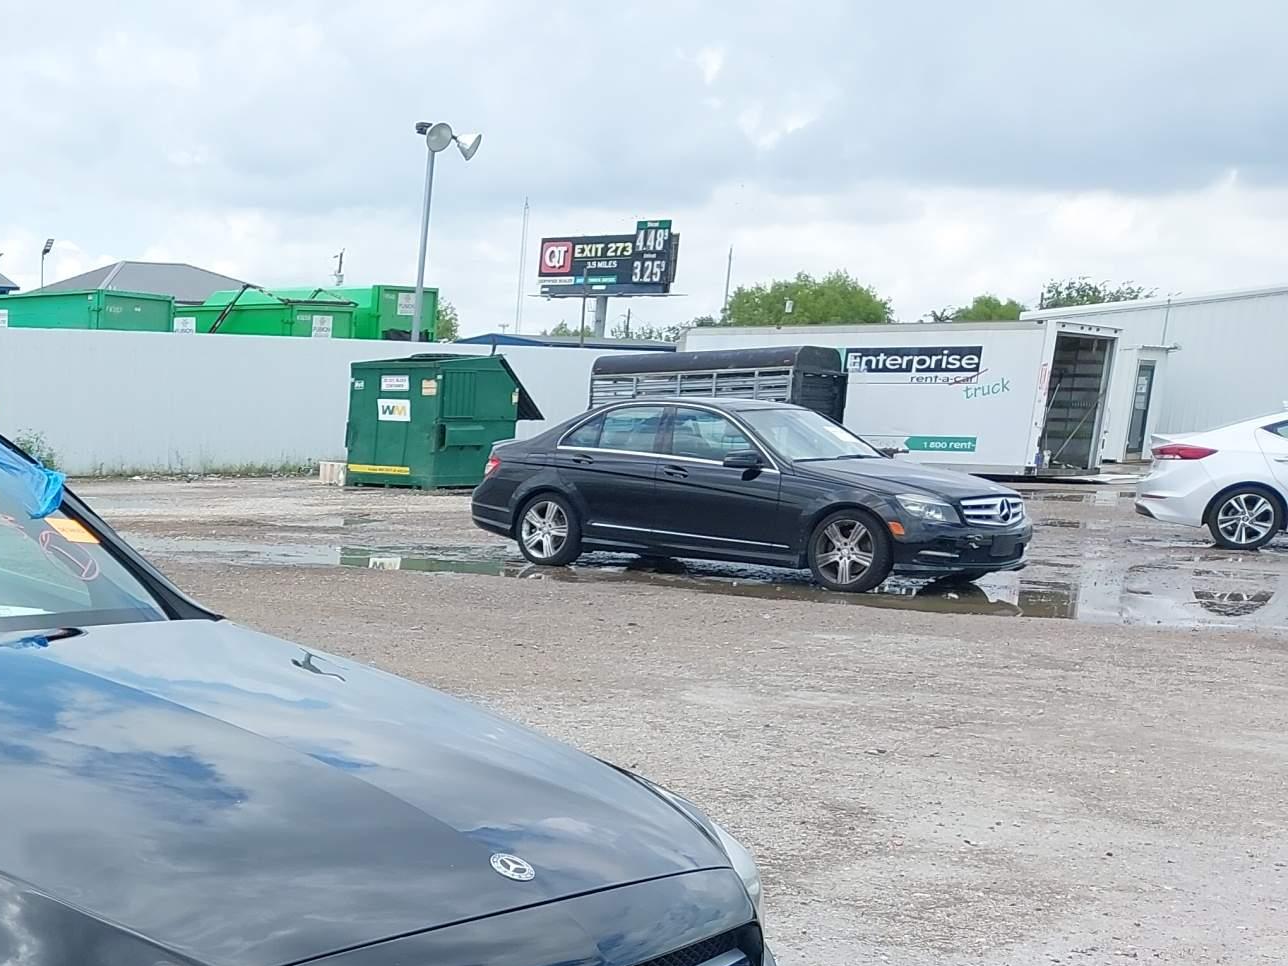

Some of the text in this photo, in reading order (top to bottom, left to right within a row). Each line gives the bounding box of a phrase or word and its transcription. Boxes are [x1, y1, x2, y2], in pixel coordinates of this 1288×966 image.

[544, 246, 569, 269] QT
[574, 242, 633, 258] EXIT 273
[597, 260, 618, 268] MILES
[846, 350, 979, 374] Enterprise
[962, 377, 1011, 399] truck
[381, 404, 407, 416] WM
[929, 441, 948, 449] 800
